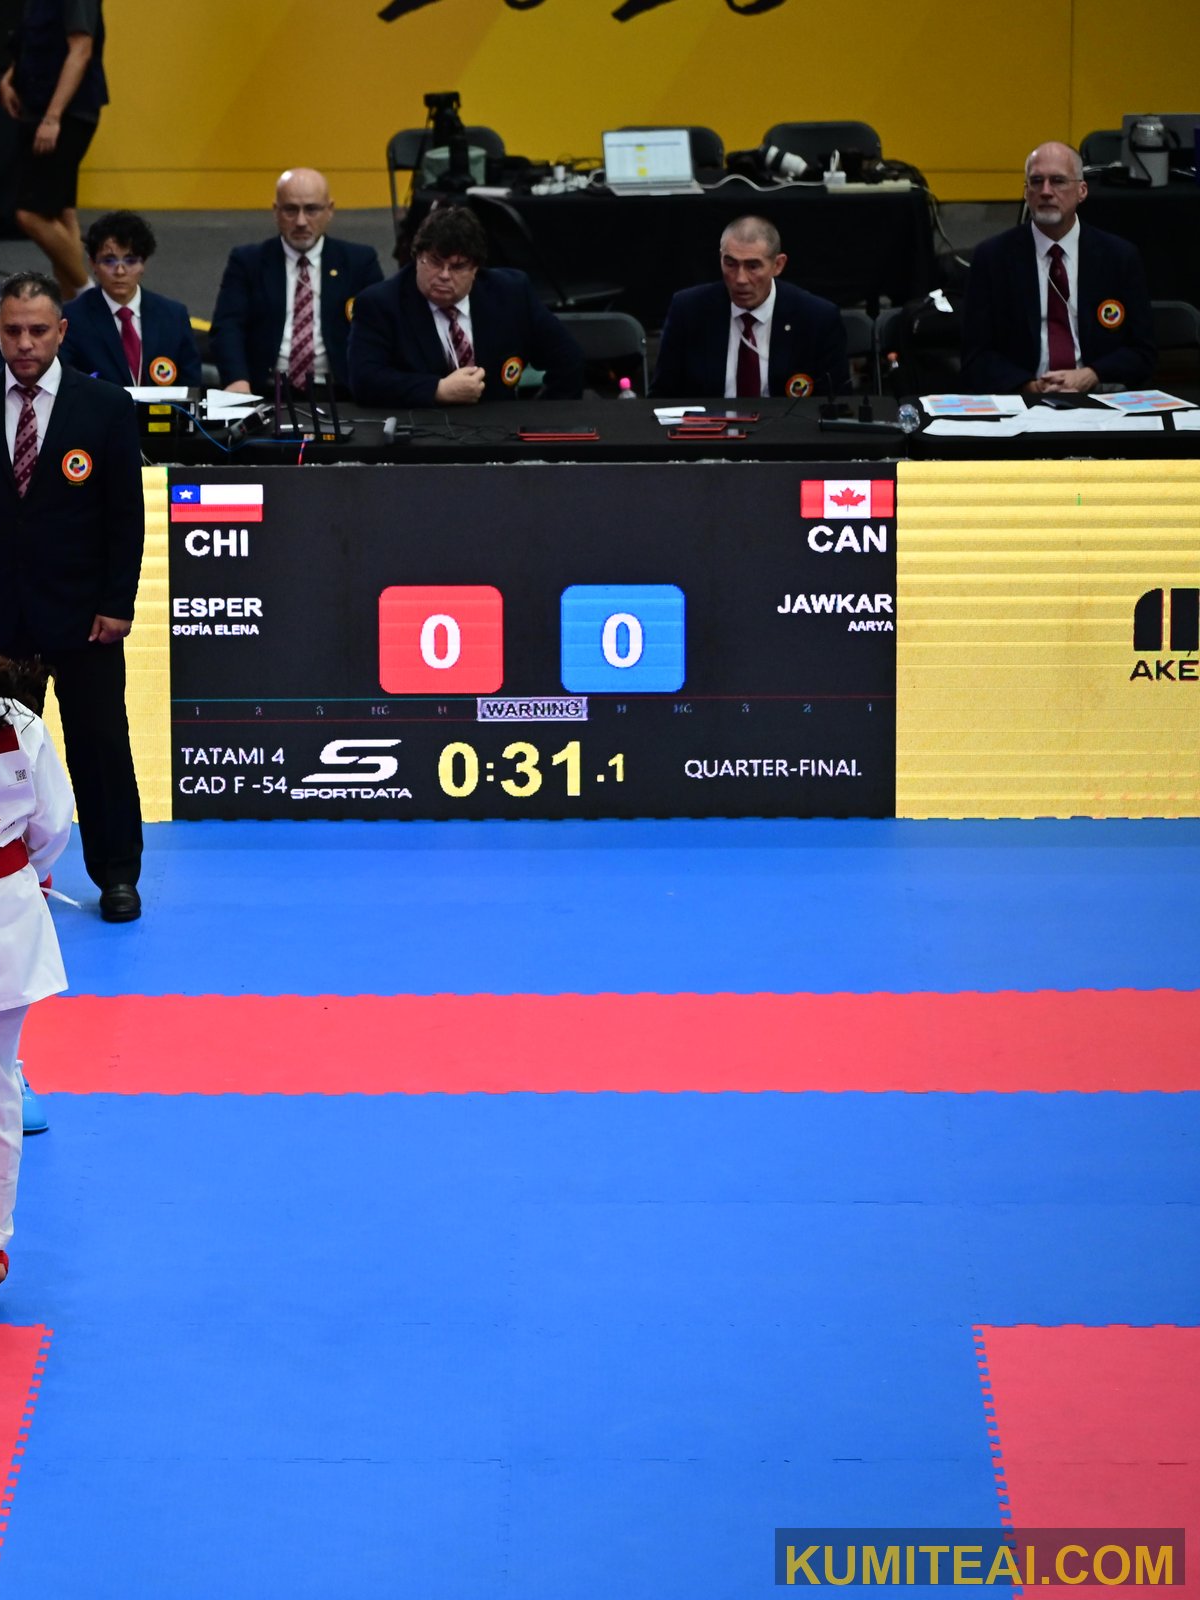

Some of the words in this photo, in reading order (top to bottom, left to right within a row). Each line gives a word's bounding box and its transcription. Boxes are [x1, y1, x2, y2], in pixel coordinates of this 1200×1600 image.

[184, 528, 249, 558] CHI
[807, 524, 887, 553] CAN
[172, 597, 264, 618] ESPER
[776, 593, 894, 614] JAWKAR
[214, 623, 260, 636] ELENA
[847, 620, 894, 632] AARYA
[420, 613, 461, 670] 0
[602, 612, 643, 668] 0
[486, 702, 581, 717] WARNING
[181, 747, 265, 765] TATAMI
[271, 747, 285, 765] 4
[179, 776, 226, 794] CAD
[234, 776, 246, 794] F
[251, 776, 288, 794] -54
[290, 787, 413, 800] SPORTDATA
